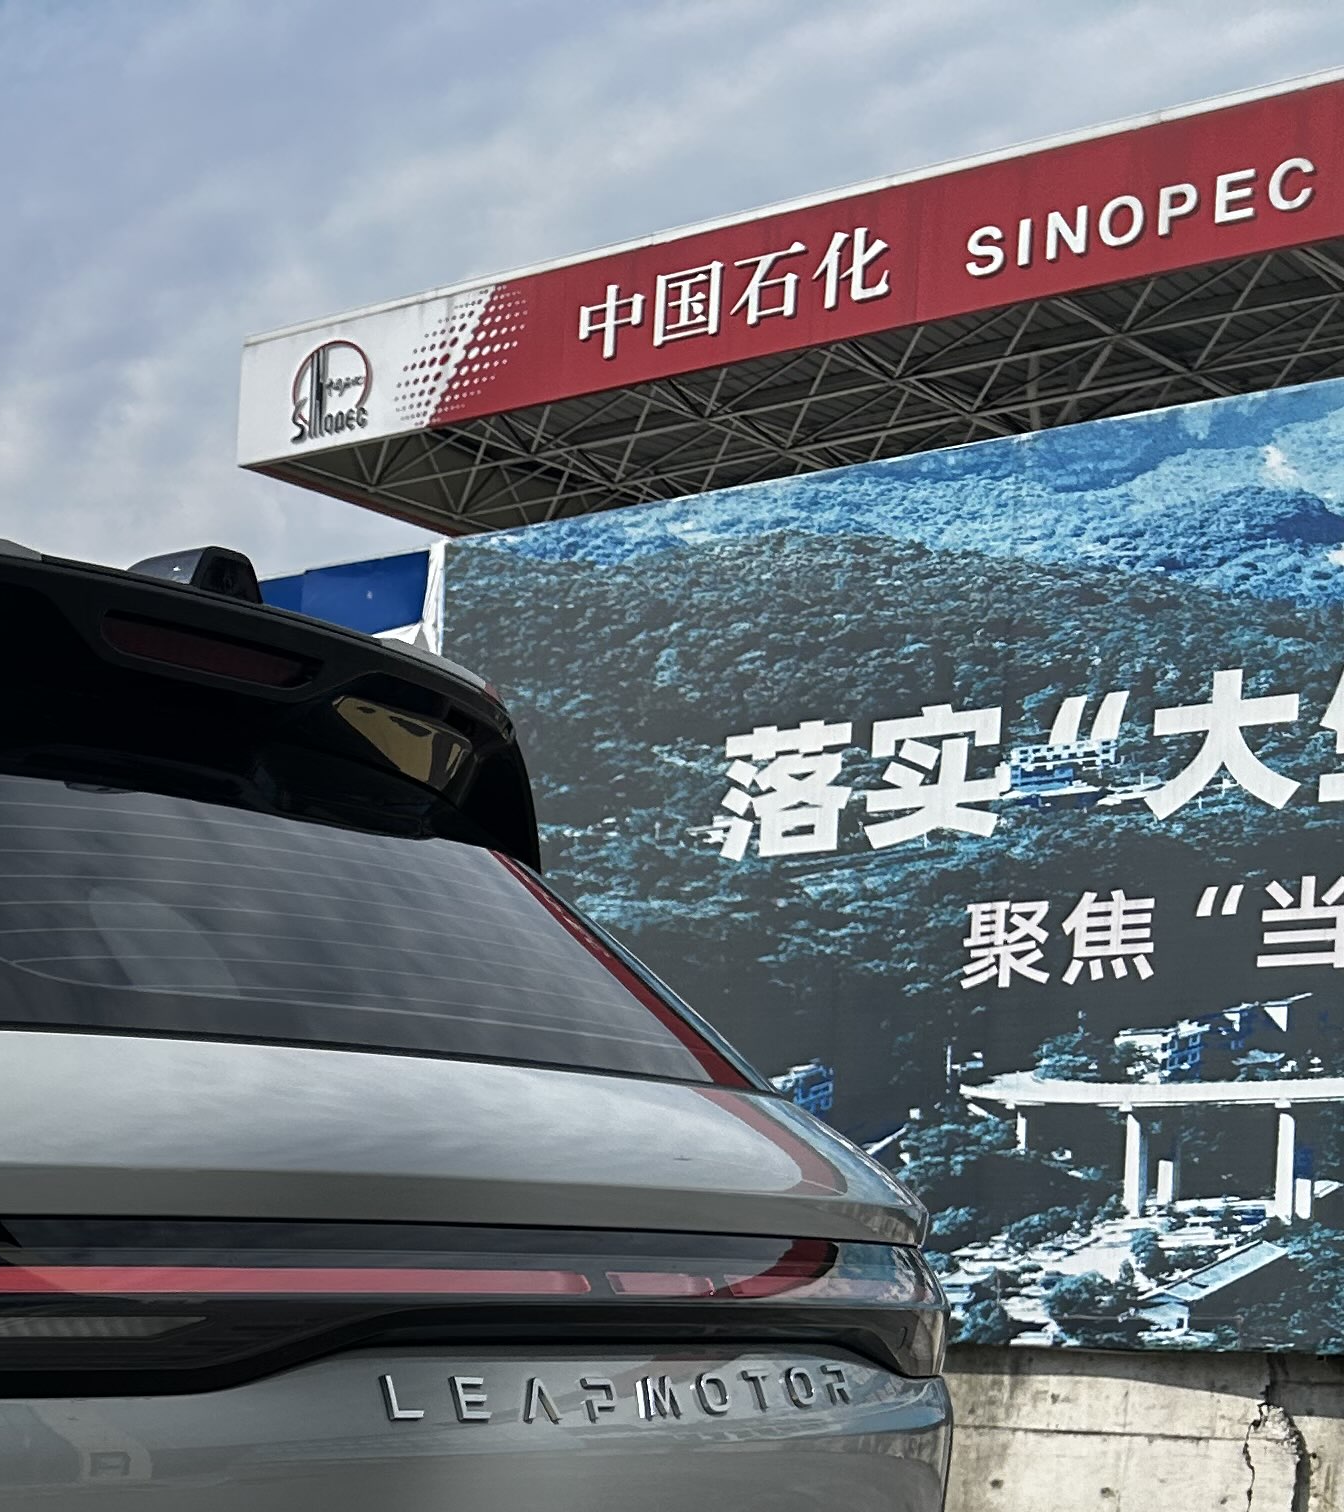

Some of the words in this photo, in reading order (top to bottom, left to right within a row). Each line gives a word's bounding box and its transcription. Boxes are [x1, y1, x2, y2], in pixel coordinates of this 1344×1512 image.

[579, 227, 890, 360] 中国石化
[966, 157, 1315, 278] SINOPEC
[378, 1364, 851, 1425] LEAPMOTOR
